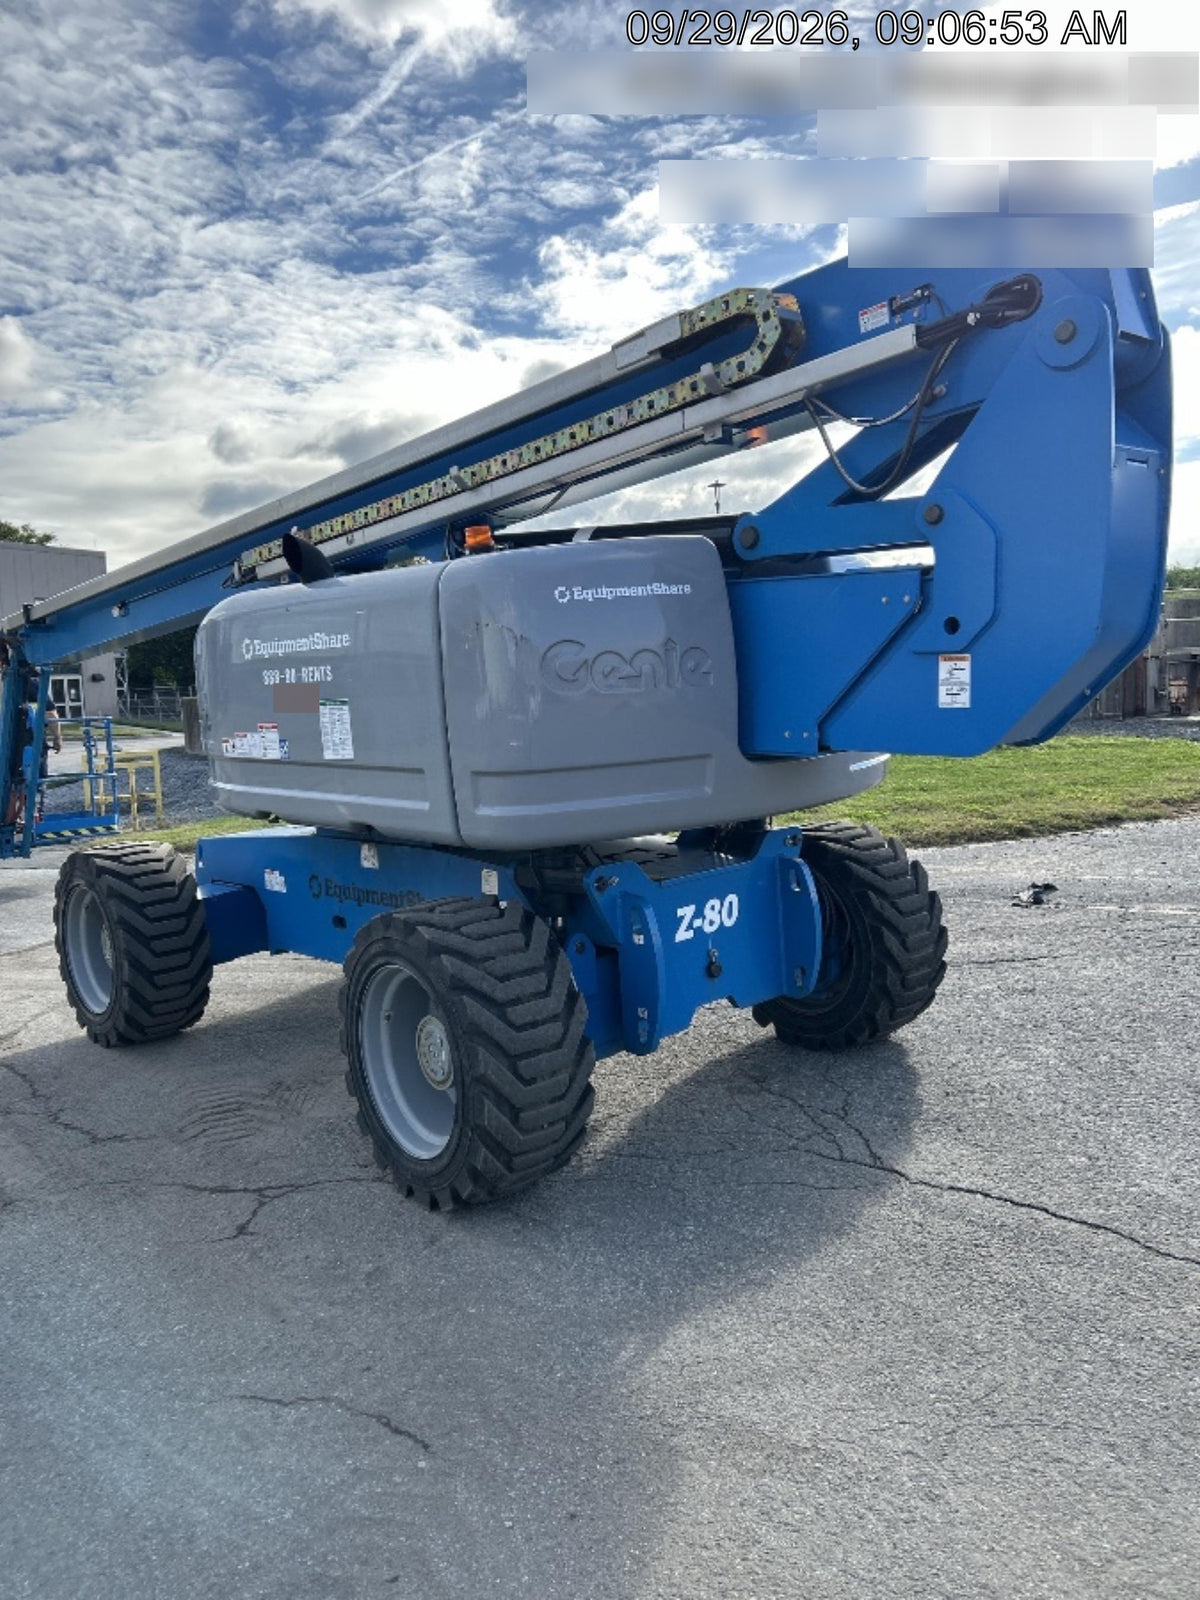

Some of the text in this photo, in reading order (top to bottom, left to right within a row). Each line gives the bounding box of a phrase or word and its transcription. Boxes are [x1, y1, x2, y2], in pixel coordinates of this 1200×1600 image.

[572, 582, 692, 602] EquipmentShare
[254, 632, 351, 658] EquipmentShare
[540, 637, 714, 696] Genie
[674, 893, 739, 943] Z-80
